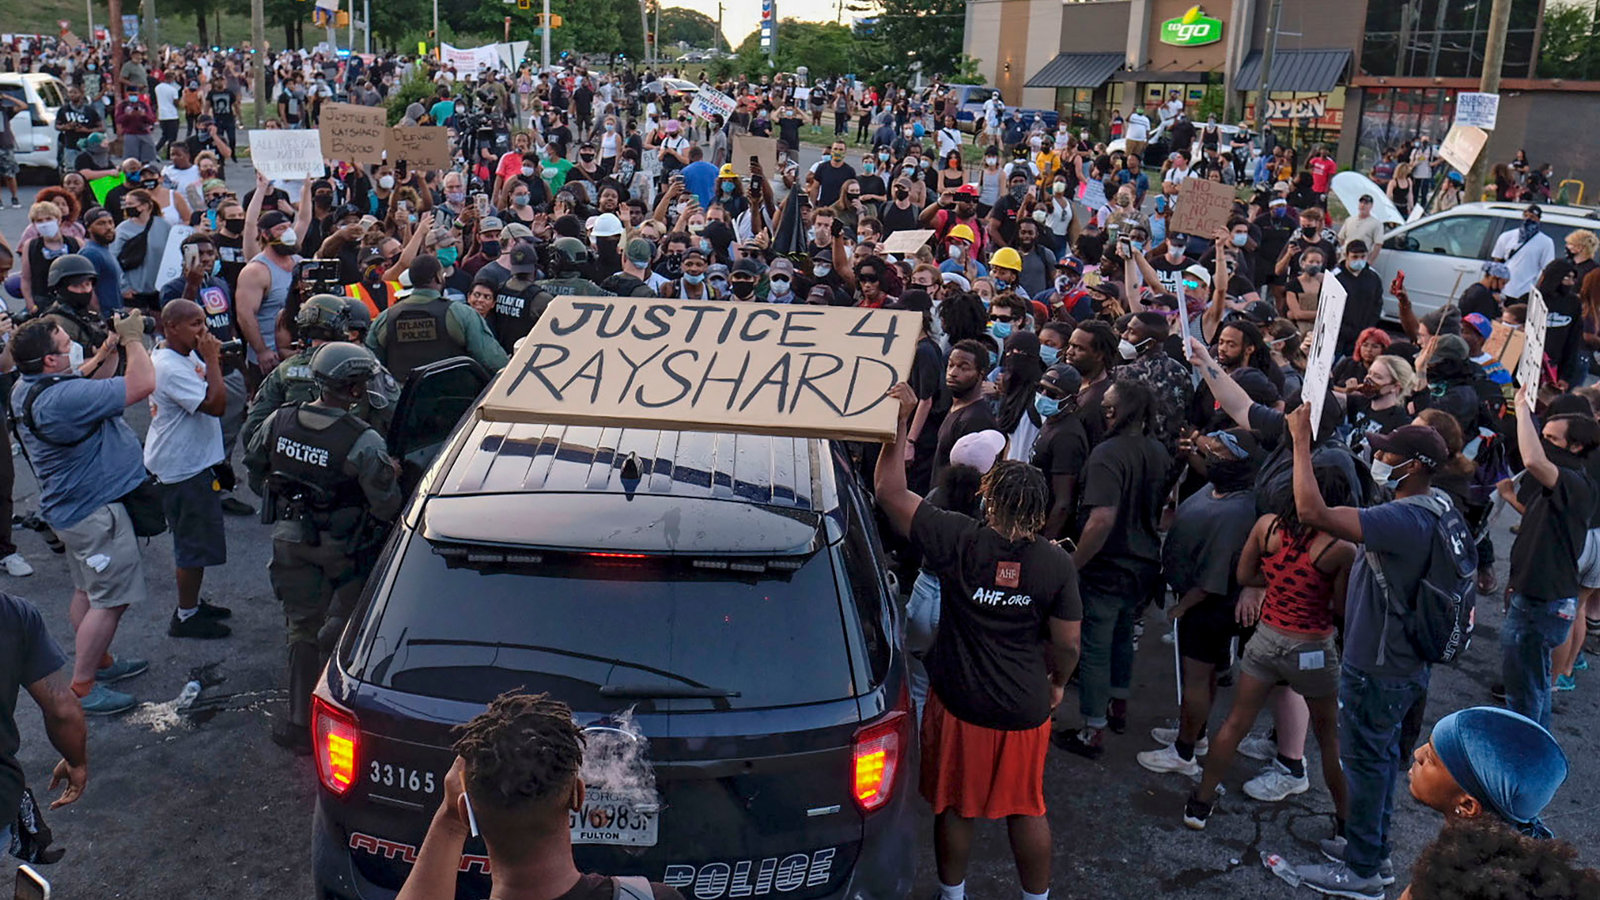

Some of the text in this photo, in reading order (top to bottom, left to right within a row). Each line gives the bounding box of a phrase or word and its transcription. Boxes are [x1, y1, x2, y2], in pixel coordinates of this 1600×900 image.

[1168, 23, 1210, 41] to go
[1192, 180, 1211, 192] NO
[1190, 205, 1208, 216] NO
[541, 284, 576, 295] POLICE
[550, 302, 900, 356] JUSTICE 4
[507, 344, 899, 418] RAYSHARD
[276, 441, 329, 467] POLICE
[301, 444, 329, 456] ATLANTA
[999, 568, 1017, 579] AHF
[972, 587, 1032, 606] AHF.ORG
[370, 760, 435, 793] 33165
[580, 832, 620, 840] FULTON
[664, 848, 836, 900] POLICE
